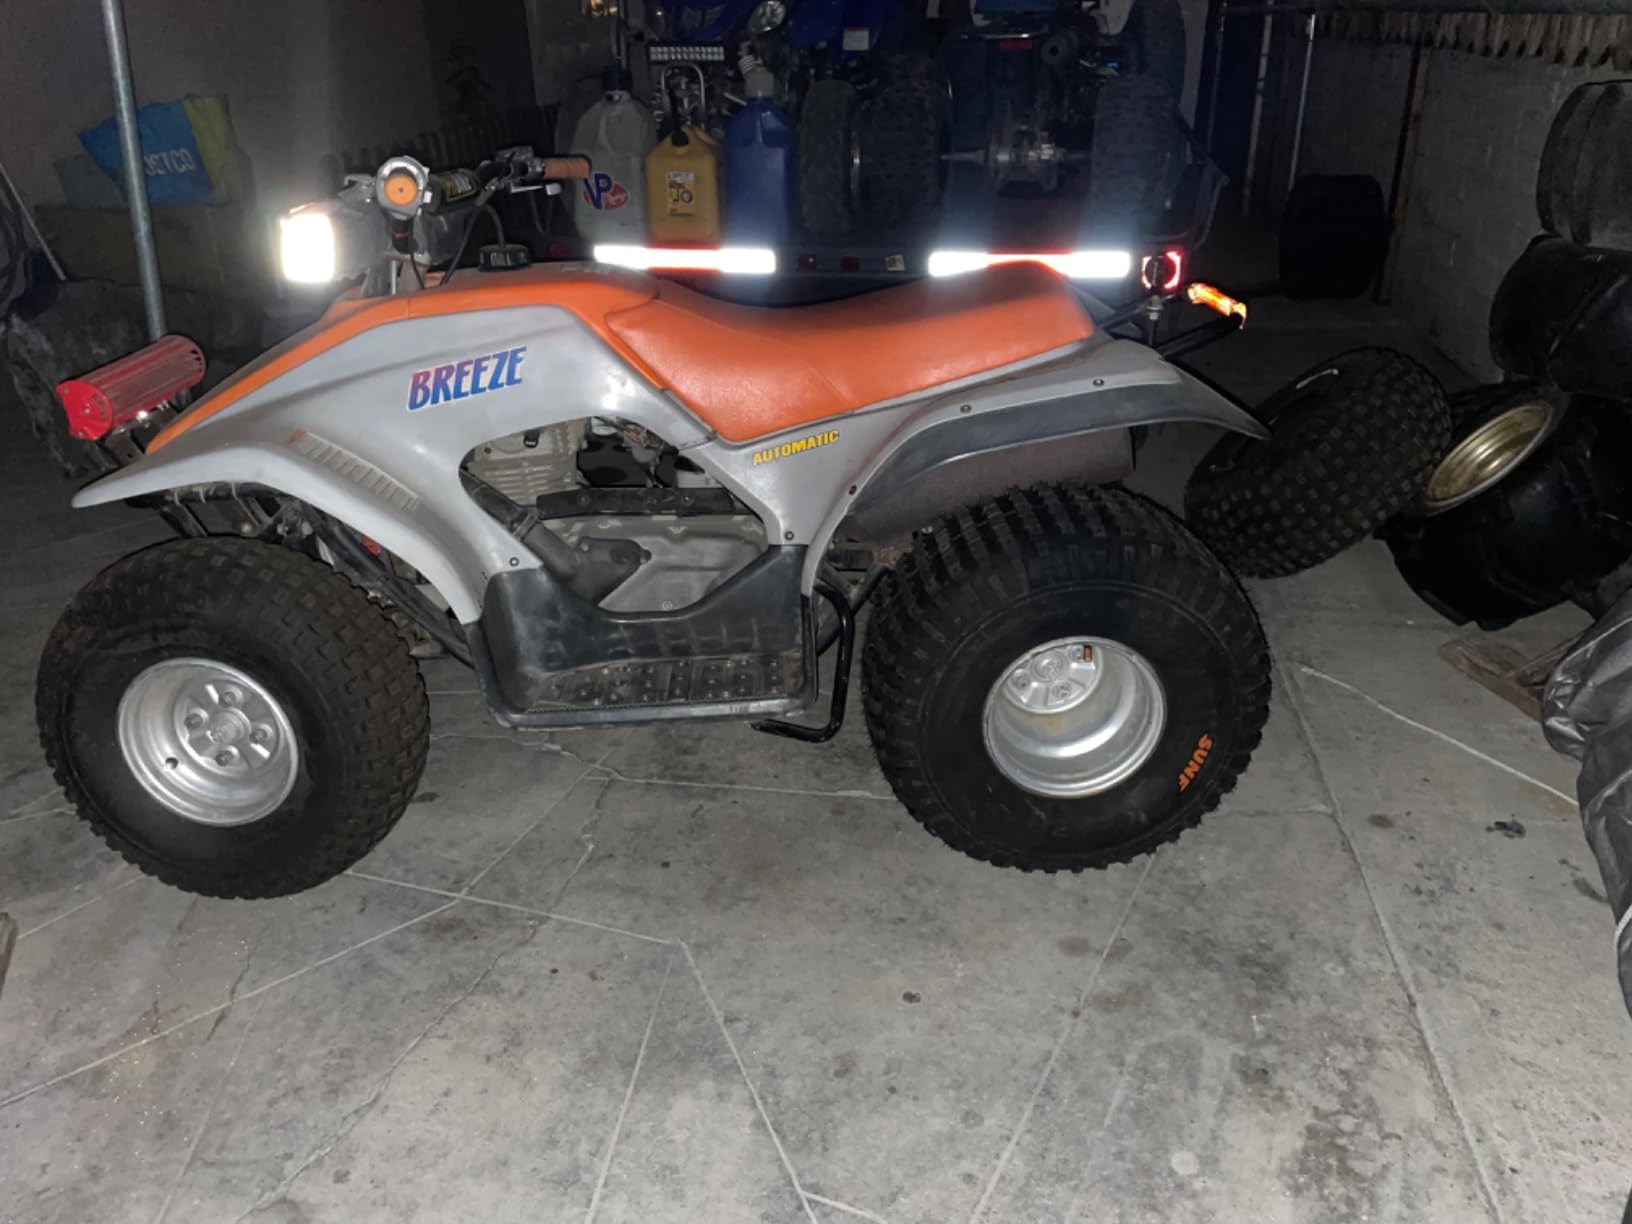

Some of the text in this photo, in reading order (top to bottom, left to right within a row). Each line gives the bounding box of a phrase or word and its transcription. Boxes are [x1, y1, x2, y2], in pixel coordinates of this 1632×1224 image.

[583, 172, 613, 210] VP
[407, 345, 528, 411] BREEZE
[753, 430, 840, 465] AUTOMATIC
